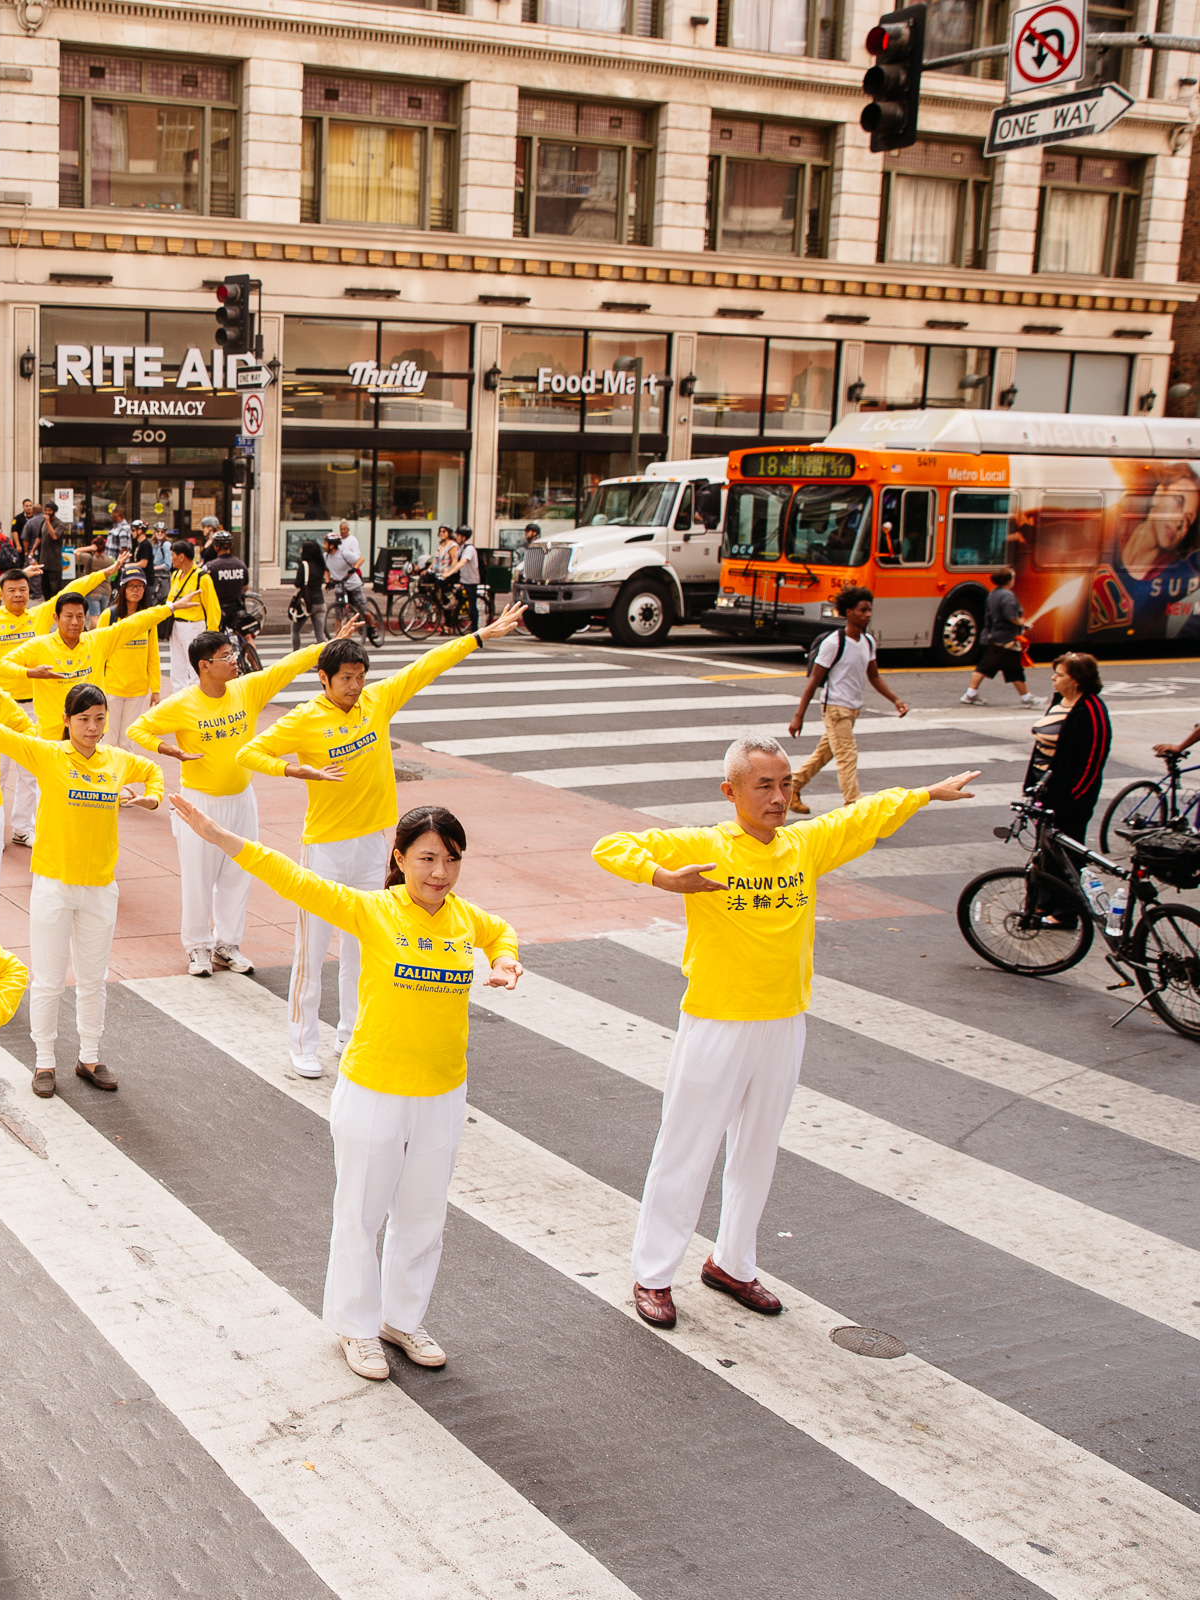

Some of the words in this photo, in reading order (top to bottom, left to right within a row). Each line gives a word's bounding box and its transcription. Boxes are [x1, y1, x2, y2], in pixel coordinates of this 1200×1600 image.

[999, 113, 1039, 140] ONE
[1053, 101, 1099, 129] WAY
[57, 345, 164, 387] RITE
[348, 360, 428, 393] Thrifty
[538, 367, 596, 394] Food
[603, 369, 658, 395] Mart
[113, 396, 206, 416] PHARMACY
[859, 413, 930, 432] Local
[132, 429, 166, 443] 500
[1029, 420, 1111, 447] Metro
[758, 456, 777, 475] 18
[830, 465, 851, 476] STA
[948, 467, 978, 481] Metro
[979, 468, 1007, 482] Local
[218, 569, 244, 581] POLICE
[1150, 575, 1200, 597] SUP
[1165, 602, 1193, 616] NEW
[198, 717, 226, 729] FALUN
[228, 710, 247, 723] DAFA
[331, 744, 356, 757] FALUN
[356, 734, 376, 747] DAFA
[71, 791, 99, 800] FALUN
[728, 876, 773, 890] FALUN
[777, 872, 804, 889] DAFA
[727, 890, 809, 910] 法輪大法
[396, 932, 473, 955] 法輪大法
[398, 966, 441, 981] FALUN
[445, 972, 473, 983] DAFA
